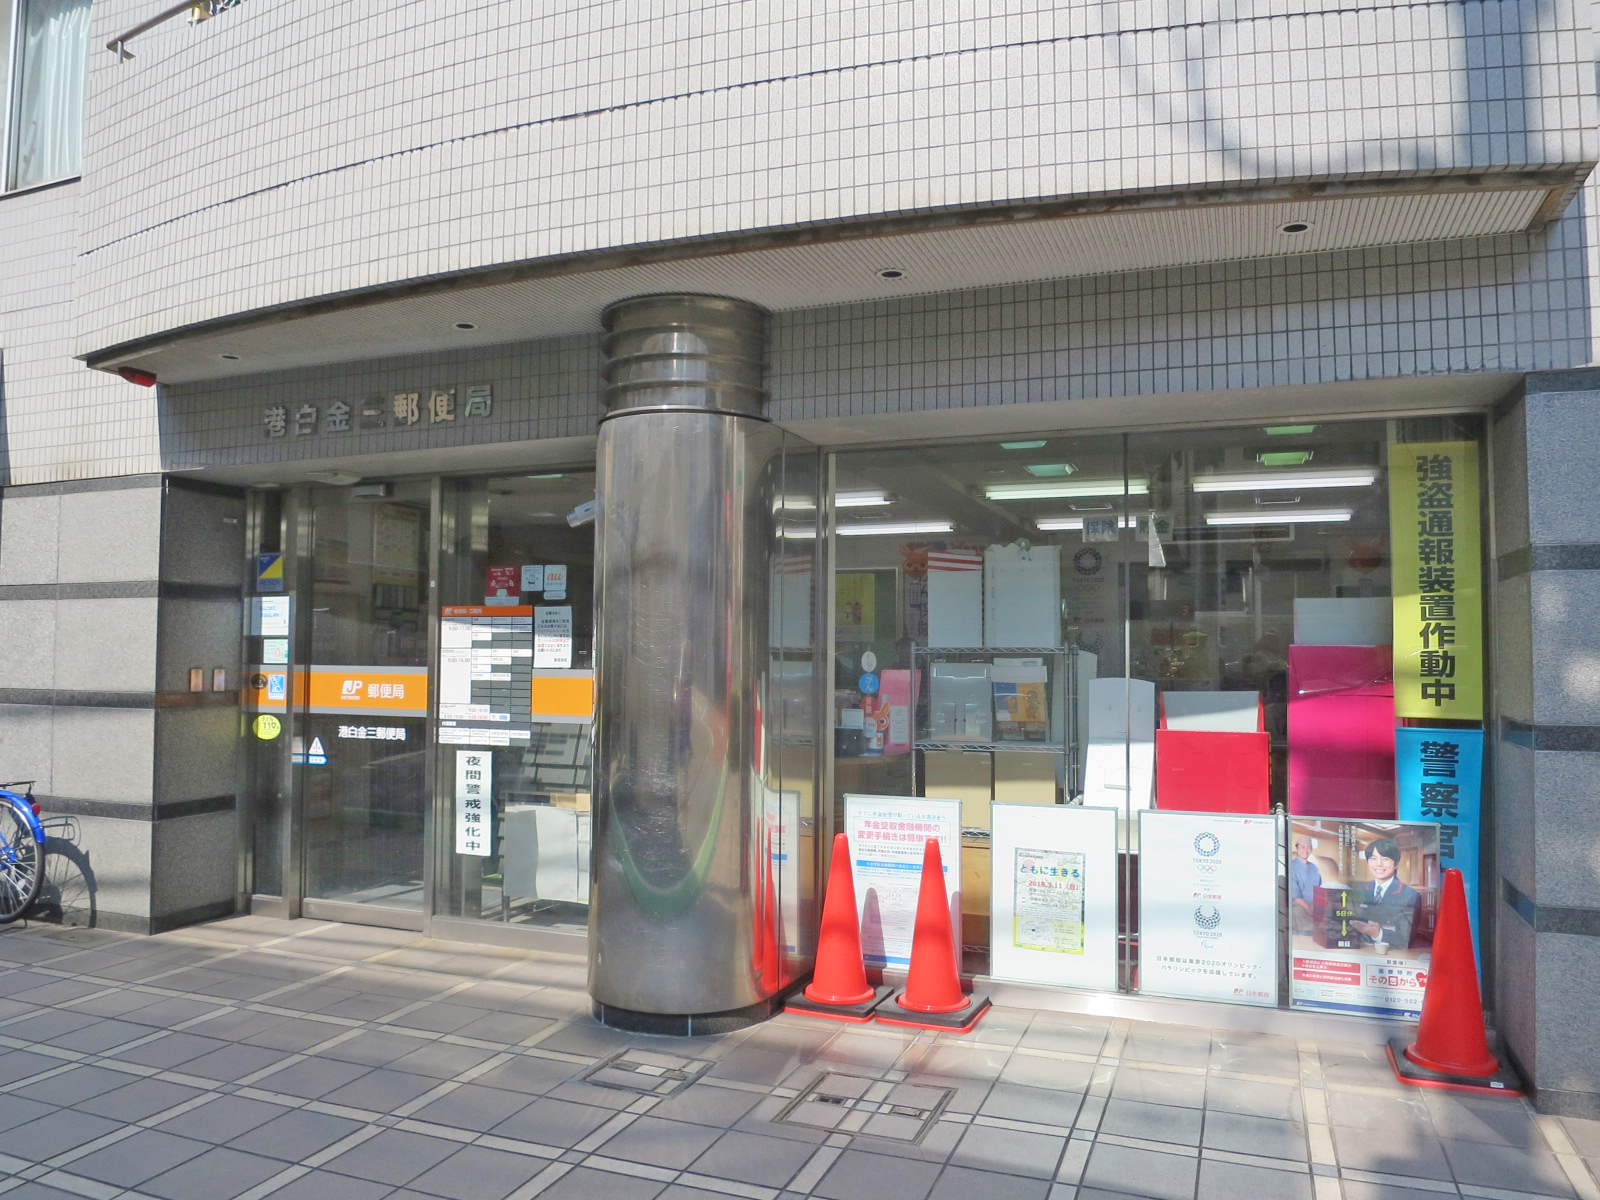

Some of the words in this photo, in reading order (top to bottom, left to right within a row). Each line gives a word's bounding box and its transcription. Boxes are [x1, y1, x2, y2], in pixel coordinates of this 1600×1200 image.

[1416, 454, 1456, 706] 強盗通報装置作動中
[367, 683, 405, 699] 郵便局
[338, 725, 406, 741] 港白金三郵便局
[464, 755, 482, 851] 夜間警戒強化中
[1420, 741, 1459, 873] 警察
[864, 820, 940, 832] 年金受取金融機関の
[1020, 864, 1080, 879] ともに生きる
